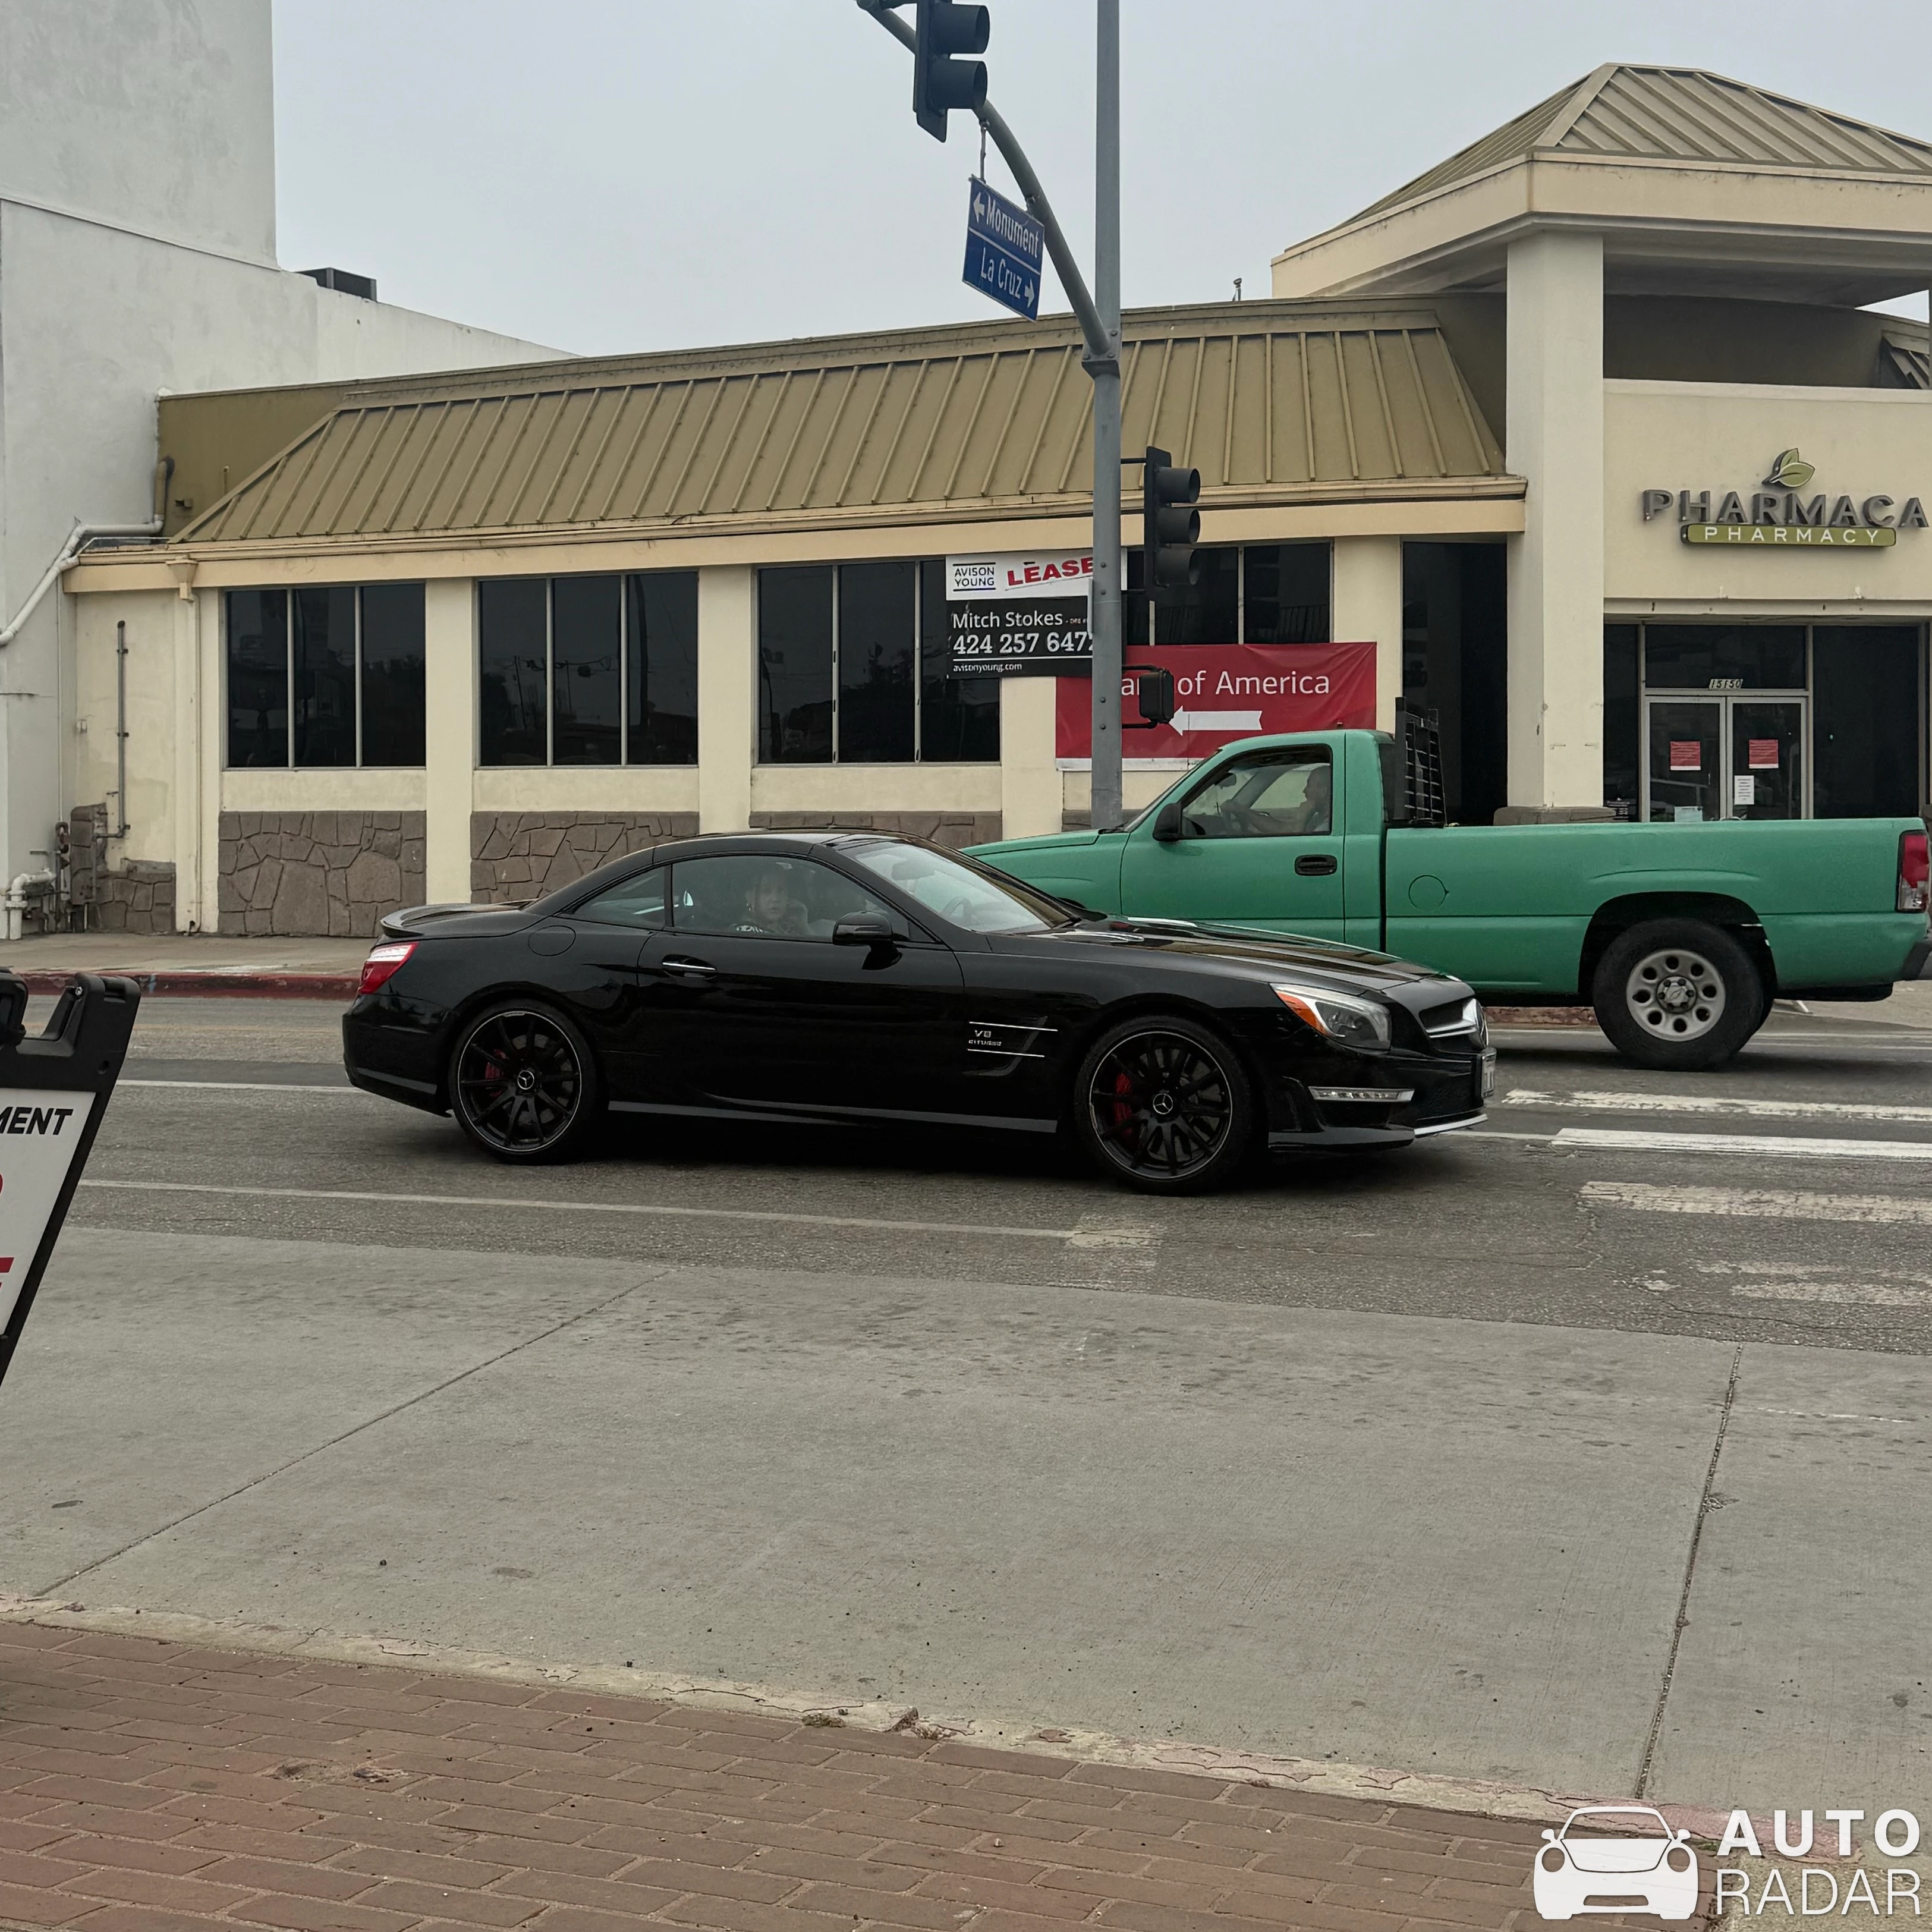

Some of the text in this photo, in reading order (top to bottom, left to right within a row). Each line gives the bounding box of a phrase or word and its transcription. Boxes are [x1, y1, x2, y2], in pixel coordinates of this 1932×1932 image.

[986, 195, 1039, 258] Monument
[981, 247, 1022, 299] La Cruz
[1641, 489, 1930, 528] PHARMACA
[1704, 526, 1879, 545] PHARMACY
[954, 567, 995, 577] AVISON
[954, 577, 995, 587] YOUNG
[953, 610, 1063, 629] Mitch Stokes
[953, 634, 993, 655] 424
[999, 633, 1040, 654] 257
[953, 663, 1022, 674] avisonyoung.com
[1177, 670, 1330, 695] of America
